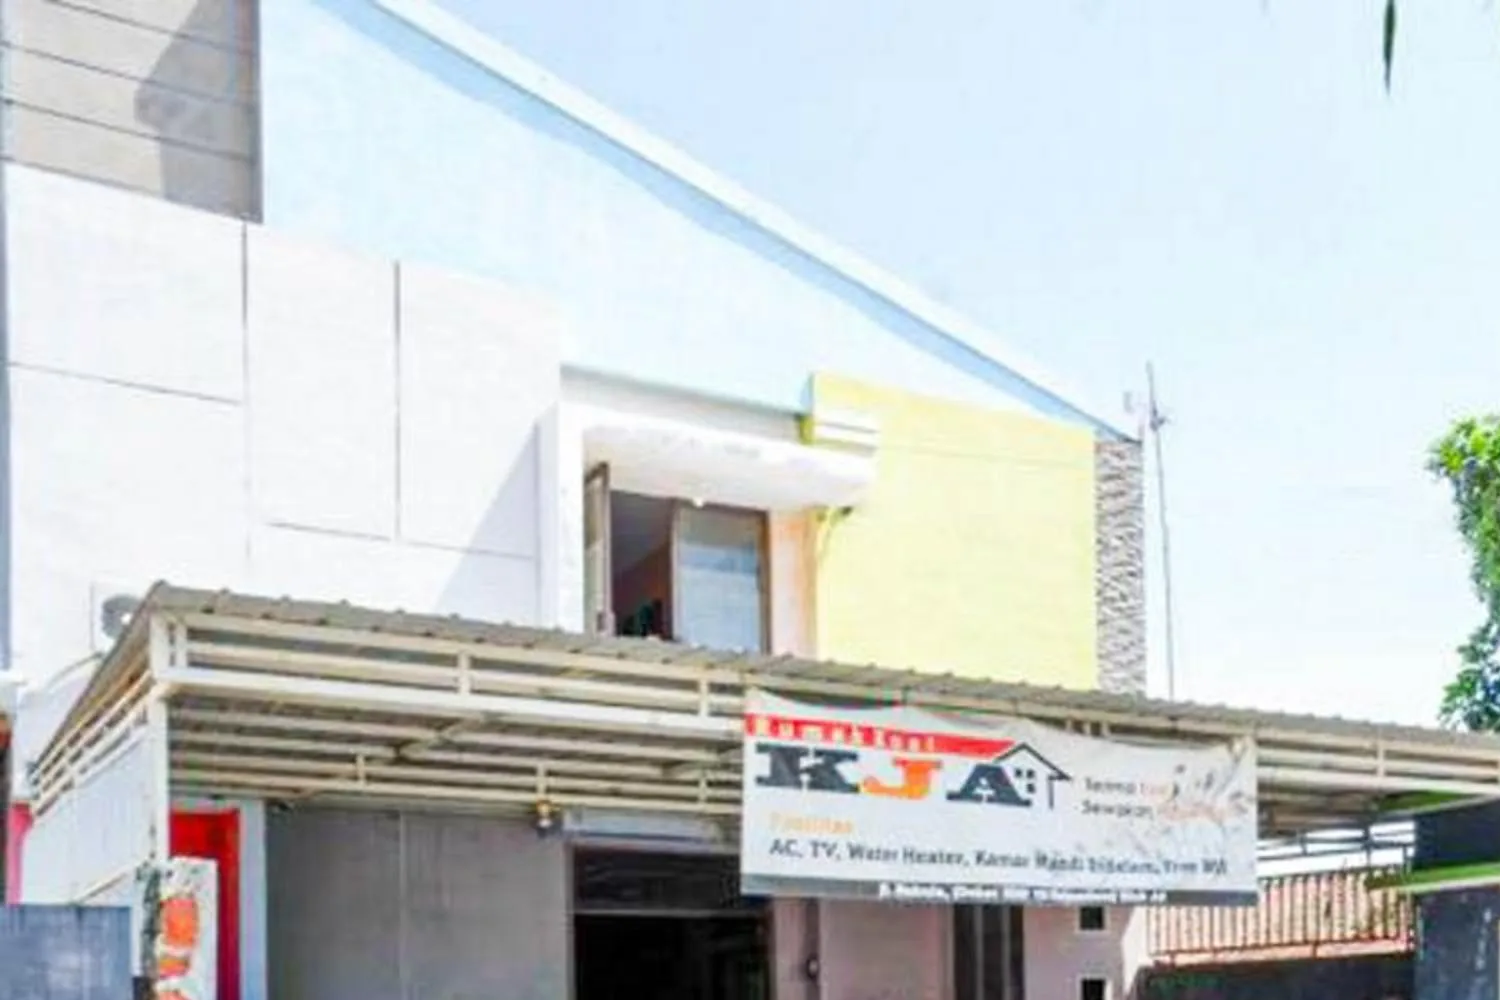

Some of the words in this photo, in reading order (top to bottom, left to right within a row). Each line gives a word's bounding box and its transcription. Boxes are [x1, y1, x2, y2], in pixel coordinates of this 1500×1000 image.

[756, 743, 1031, 806] KJA
[809, 840, 841, 860] TV,
[847, 842, 898, 862] Water
[903, 846, 970, 866] Heater,
